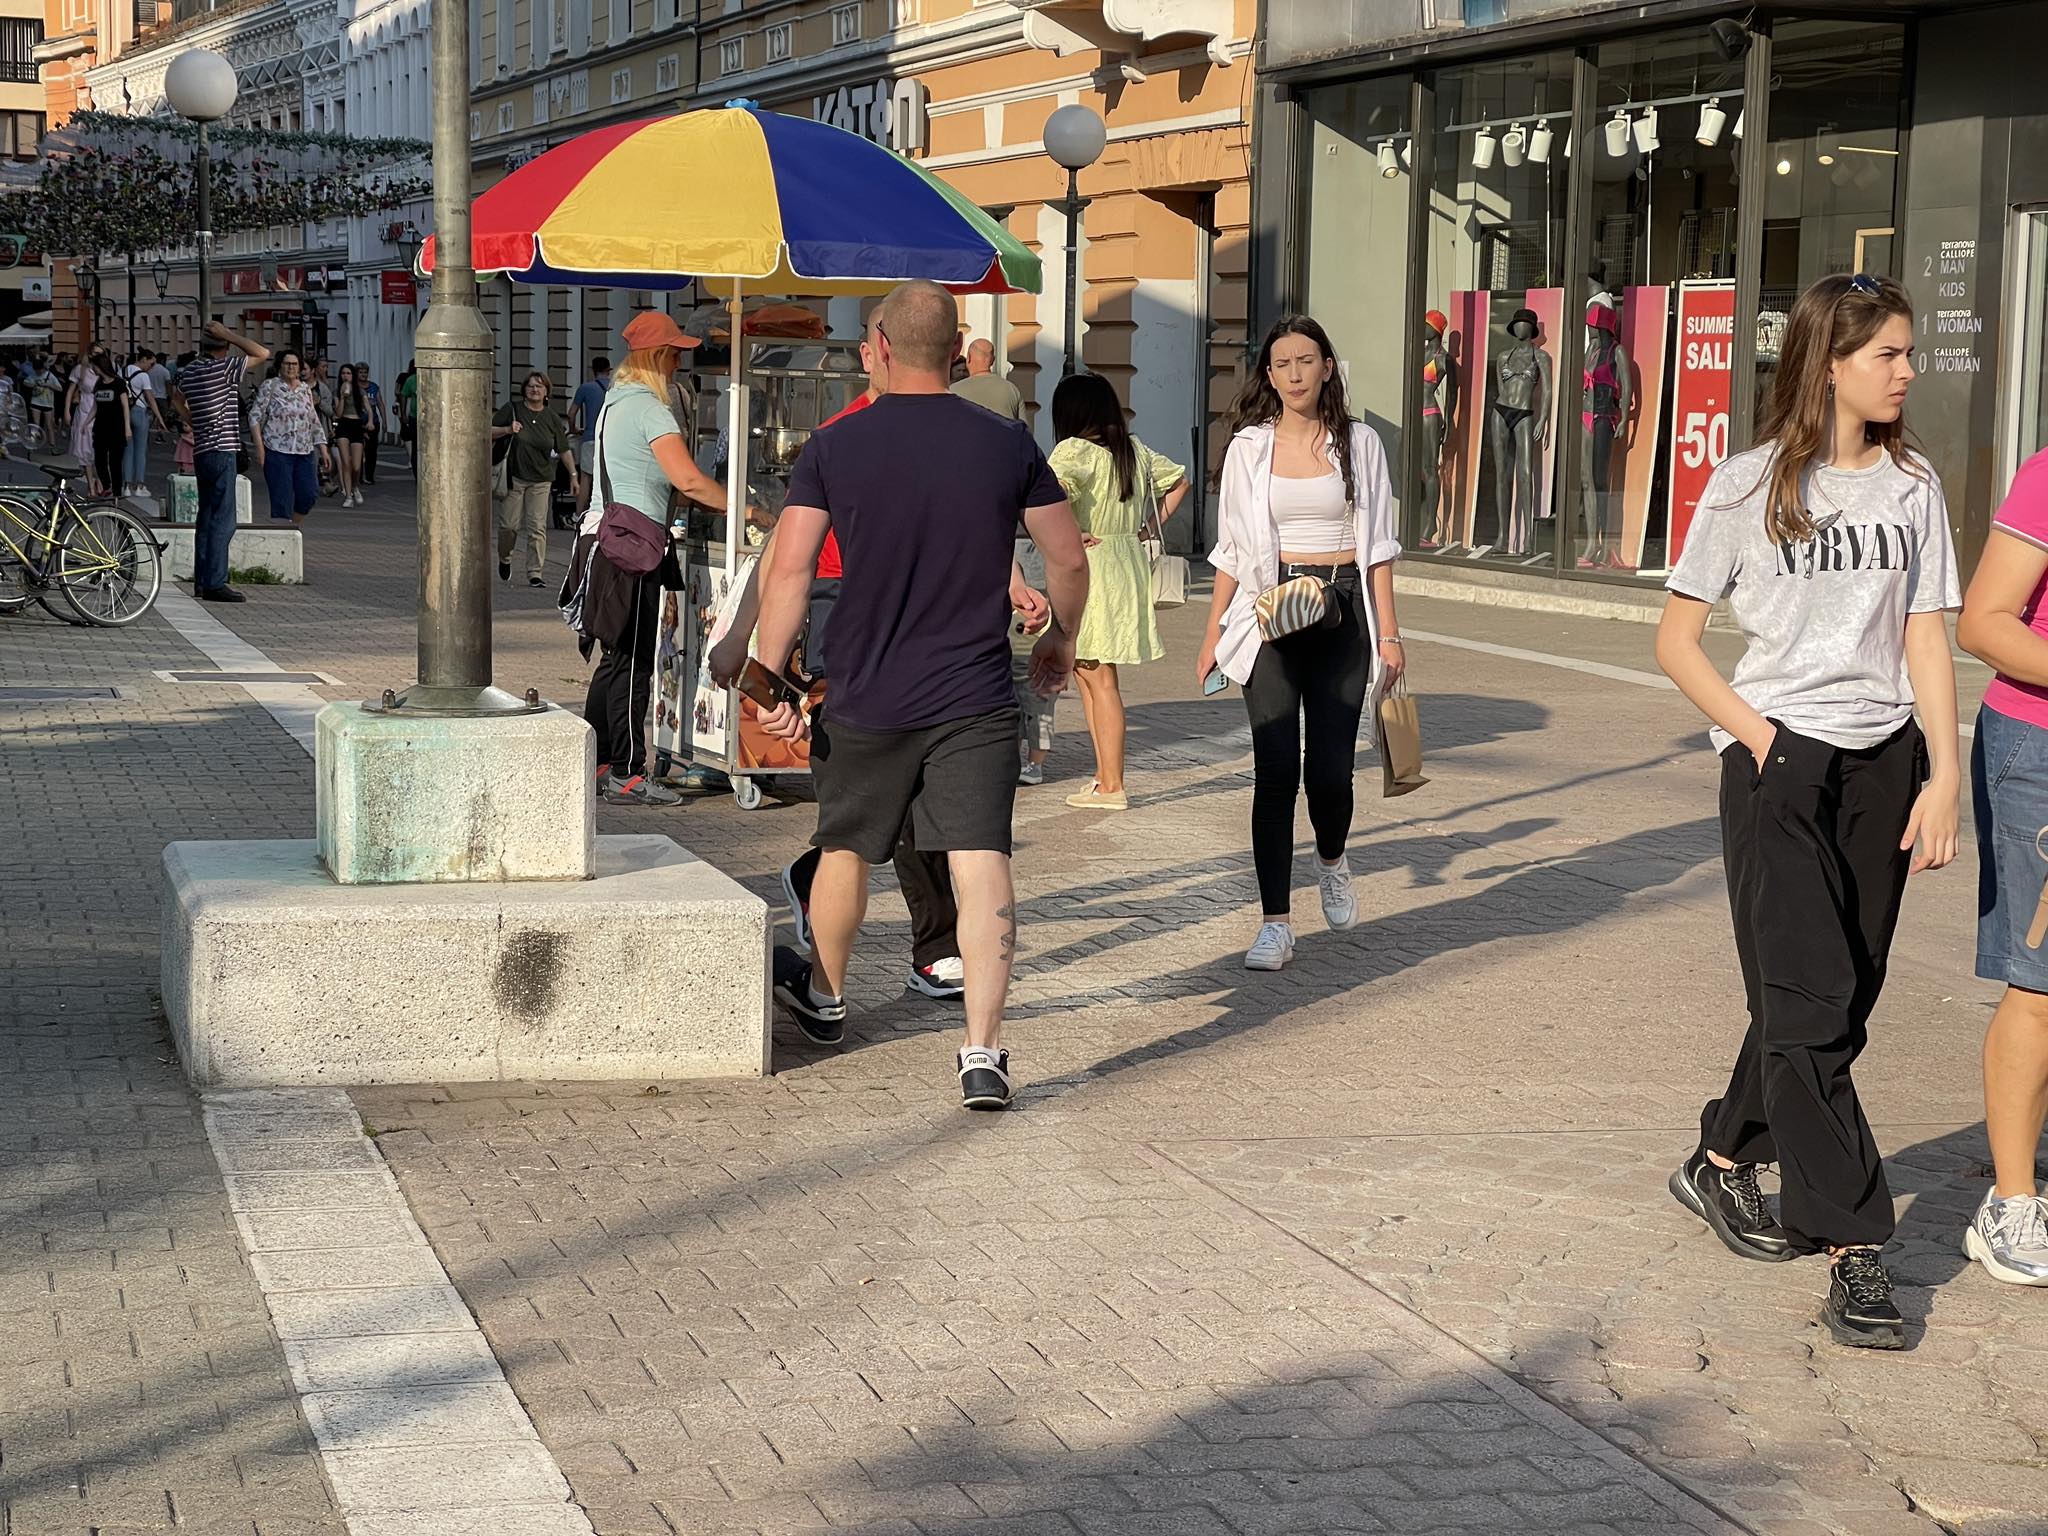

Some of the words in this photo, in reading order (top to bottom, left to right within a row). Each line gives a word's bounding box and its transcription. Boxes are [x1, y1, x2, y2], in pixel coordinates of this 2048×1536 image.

[1940, 249, 1975, 259] CALLIOPE
[1923, 255, 1933, 277] 2
[1940, 259, 1966, 274] MAN
[1939, 281, 1966, 297] KIDS
[1921, 313, 1928, 335] 1
[1937, 317, 1982, 333] WOMAN
[1934, 347, 1970, 357] CALLIOPE
[1918, 352, 1928, 374] 0
[1935, 356, 1981, 372] WOMAN
